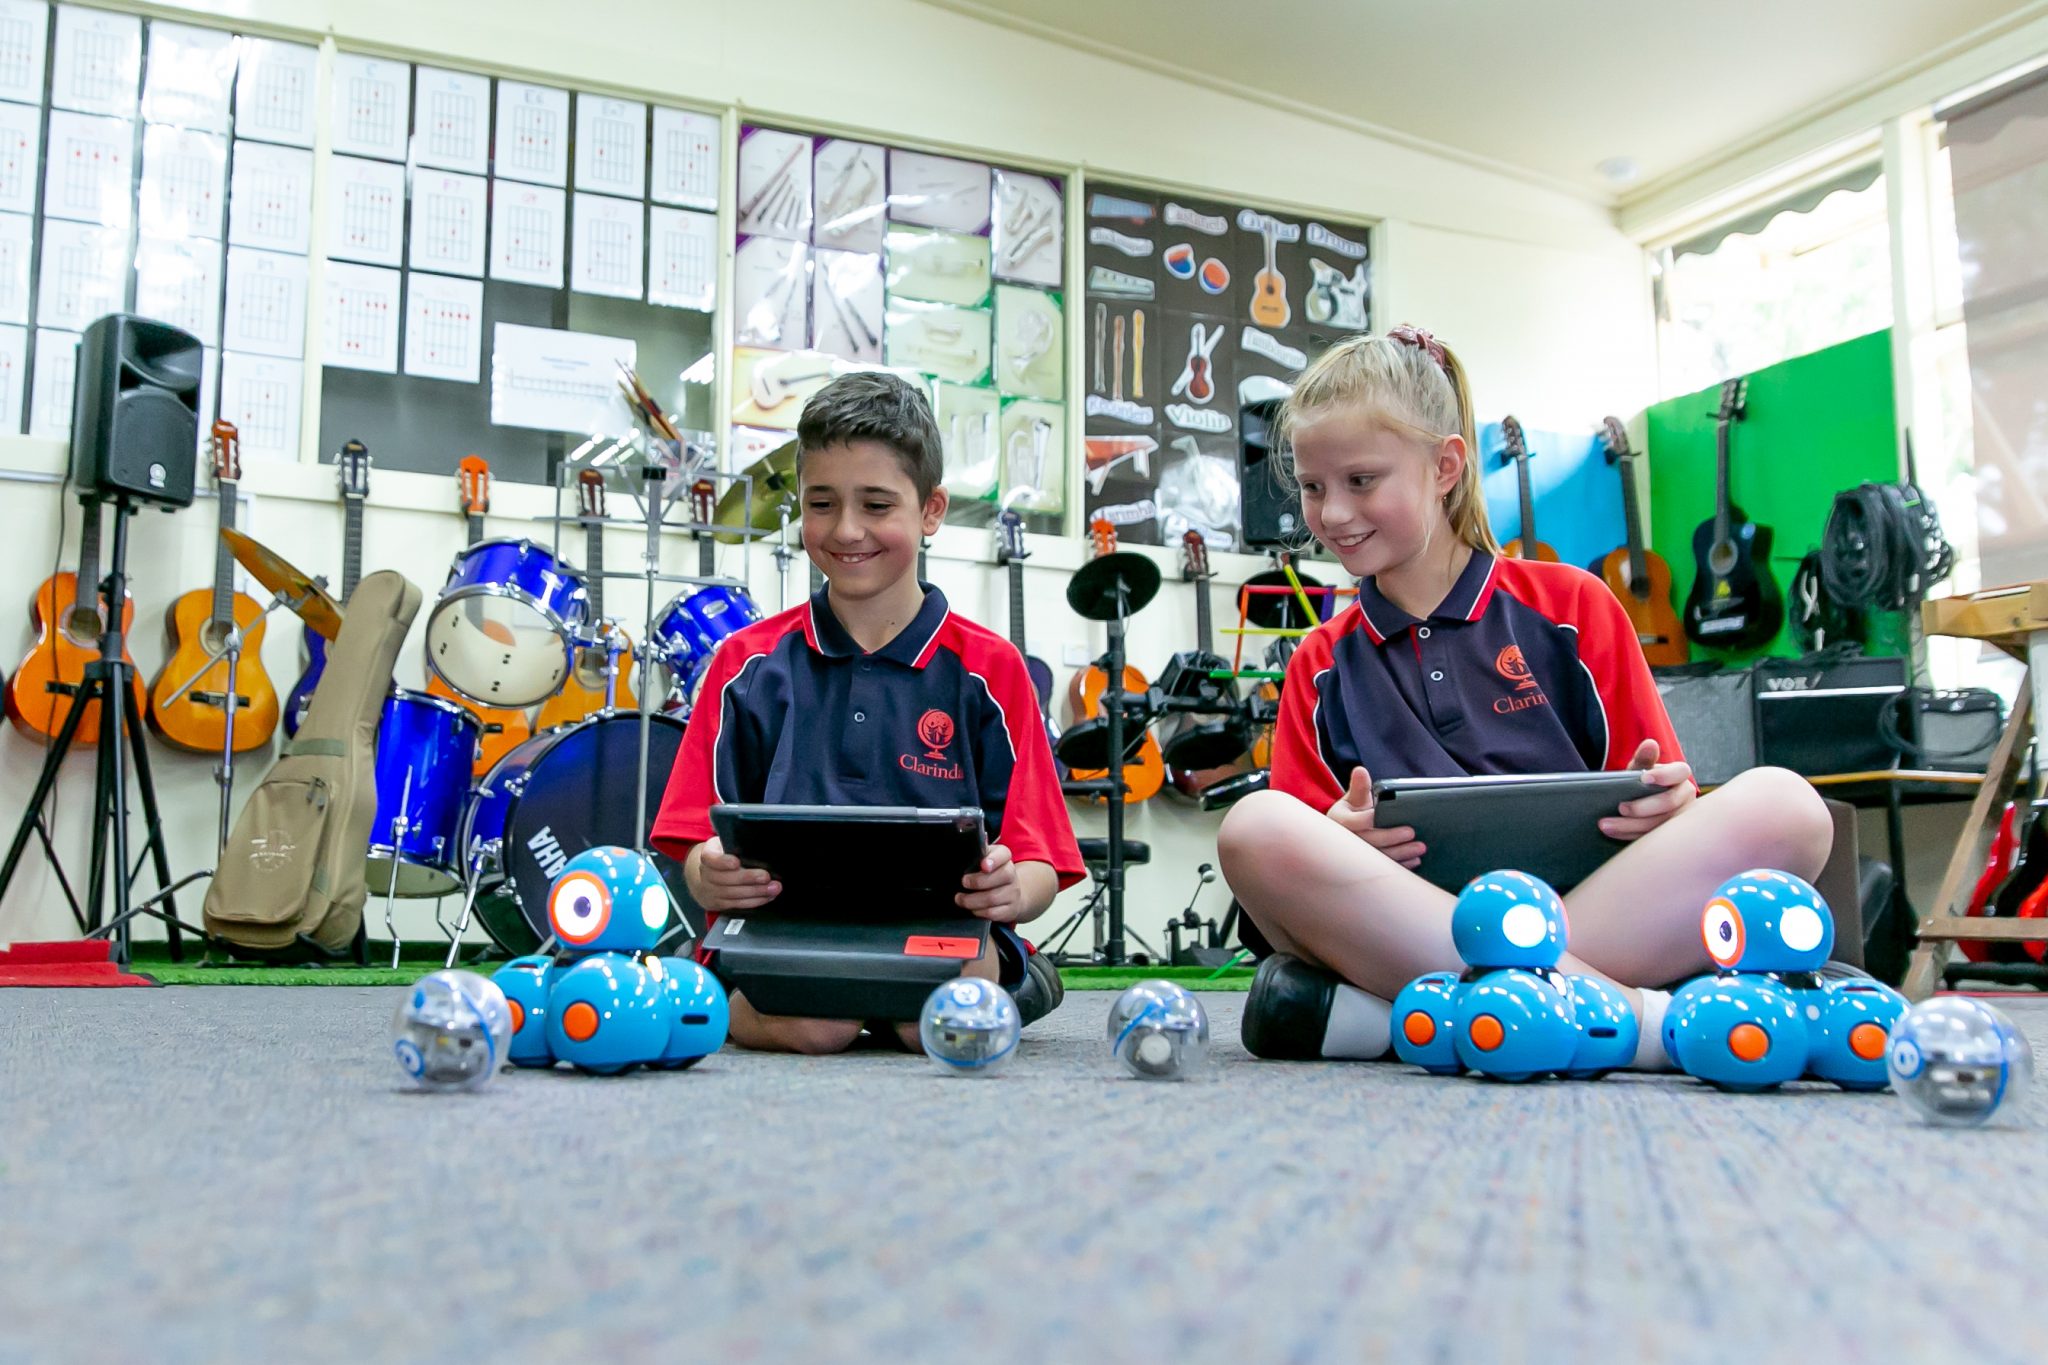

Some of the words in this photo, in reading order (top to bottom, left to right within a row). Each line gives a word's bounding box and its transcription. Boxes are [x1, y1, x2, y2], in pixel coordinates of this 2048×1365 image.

[1240, 211, 1297, 238] Gutar
[1168, 406, 1229, 429] Violin
[1767, 676, 1809, 691] VOX
[1493, 691, 1547, 714] Clarin
[527, 825, 568, 879] AHA
